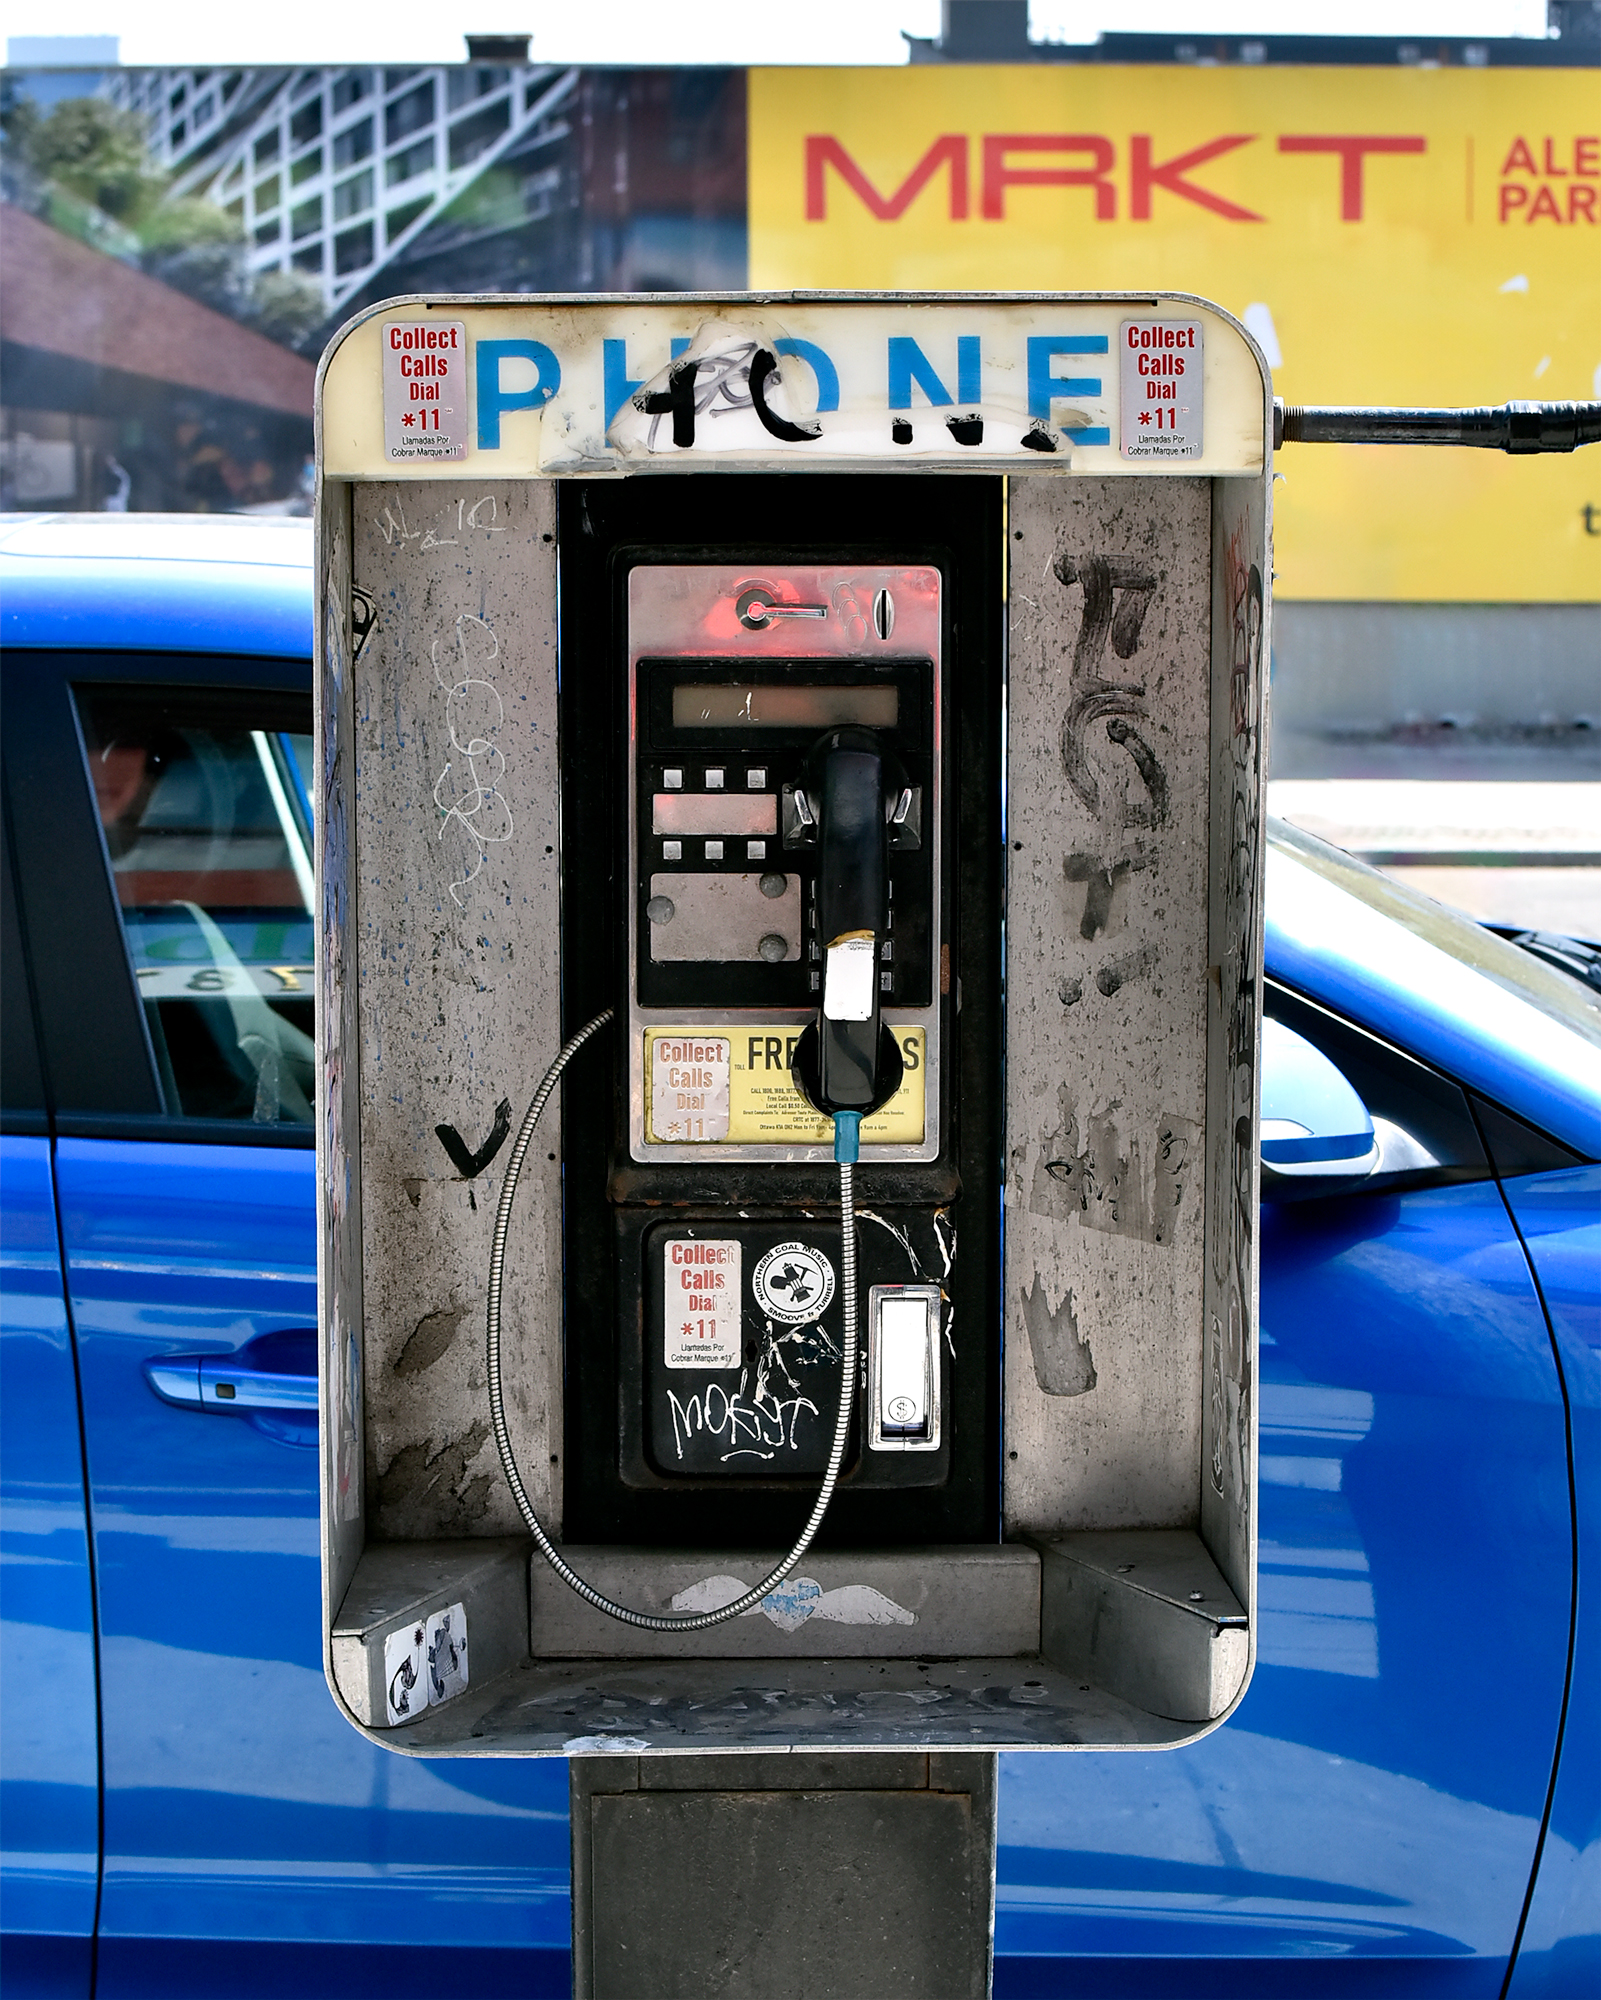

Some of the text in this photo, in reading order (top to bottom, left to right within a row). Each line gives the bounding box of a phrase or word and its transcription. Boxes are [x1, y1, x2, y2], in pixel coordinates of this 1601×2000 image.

[805, 134, 1427, 222] MRKT
[390, 327, 458, 350] Collect
[1128, 326, 1195, 349] Collect
[400, 354, 448, 377] Calls
[1138, 353, 1186, 376] Calls
[409, 381, 440, 401] Dial
[1146, 381, 1177, 400] Dial
[436, 435, 450, 445] Por
[1172, 434, 1185, 443] Por
[416, 447, 443, 458] Marque
[1152, 446, 1179, 458] Marque
[660, 1042, 723, 1064] Collect
[669, 1067, 713, 1088] Calls
[676, 1092, 705, 1111] Dial
[671, 1244, 735, 1266] Collect
[681, 1269, 725, 1290] Calls
[755, 1243, 828, 1301] NORTHERN COAL MUSIC
[689, 1294, 718, 1311] Dial
[814, 1275, 833, 1312] TURRELL
